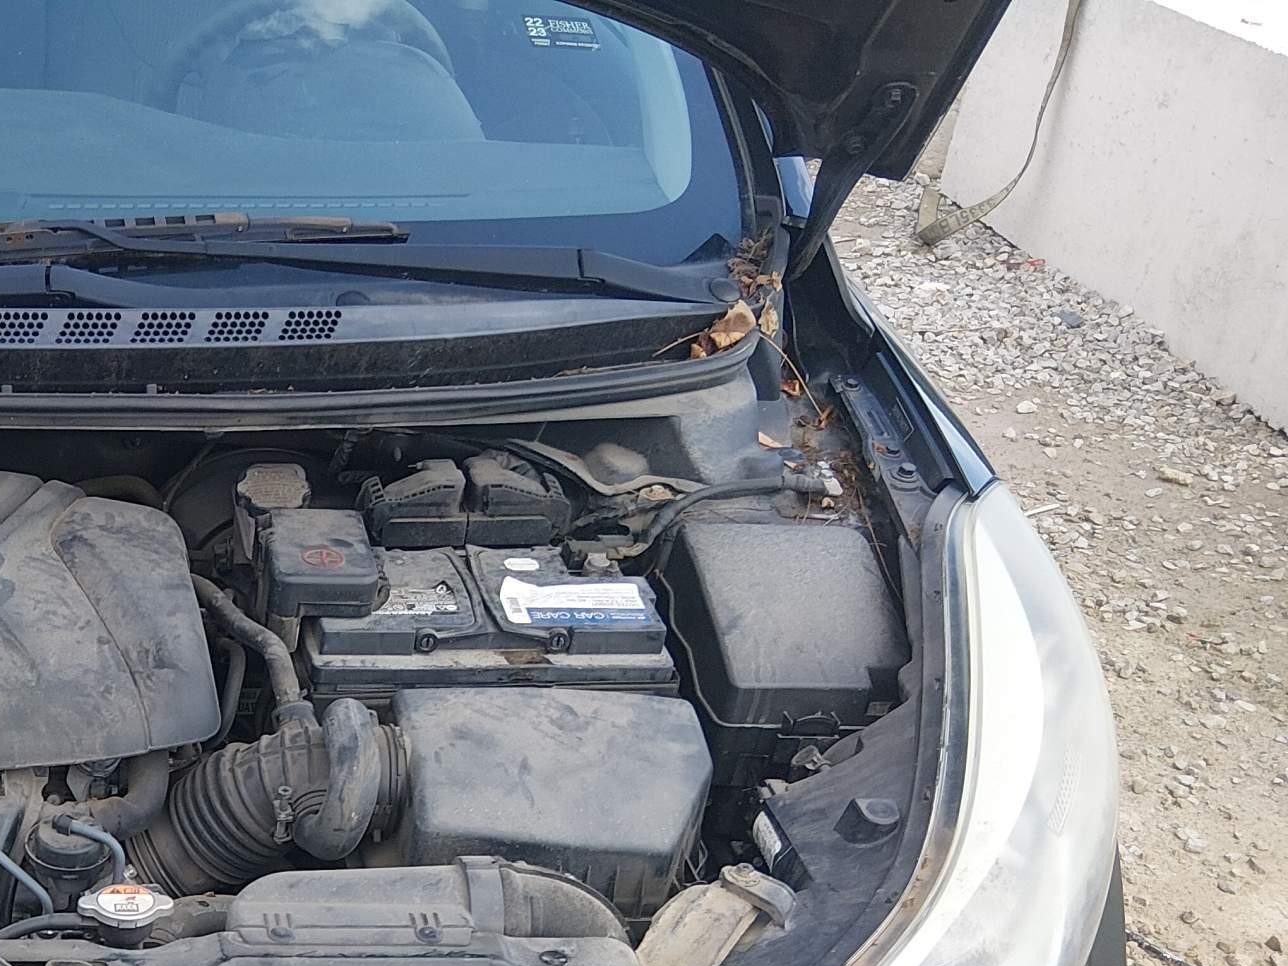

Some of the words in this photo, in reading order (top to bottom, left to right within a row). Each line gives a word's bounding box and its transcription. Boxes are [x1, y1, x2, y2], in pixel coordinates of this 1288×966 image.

[524, 17, 544, 26] 22
[548, 19, 591, 30] FISHER
[527, 27, 547, 37] 23
[530, 611, 571, 620] CARE
[574, 611, 605, 620] CAR
